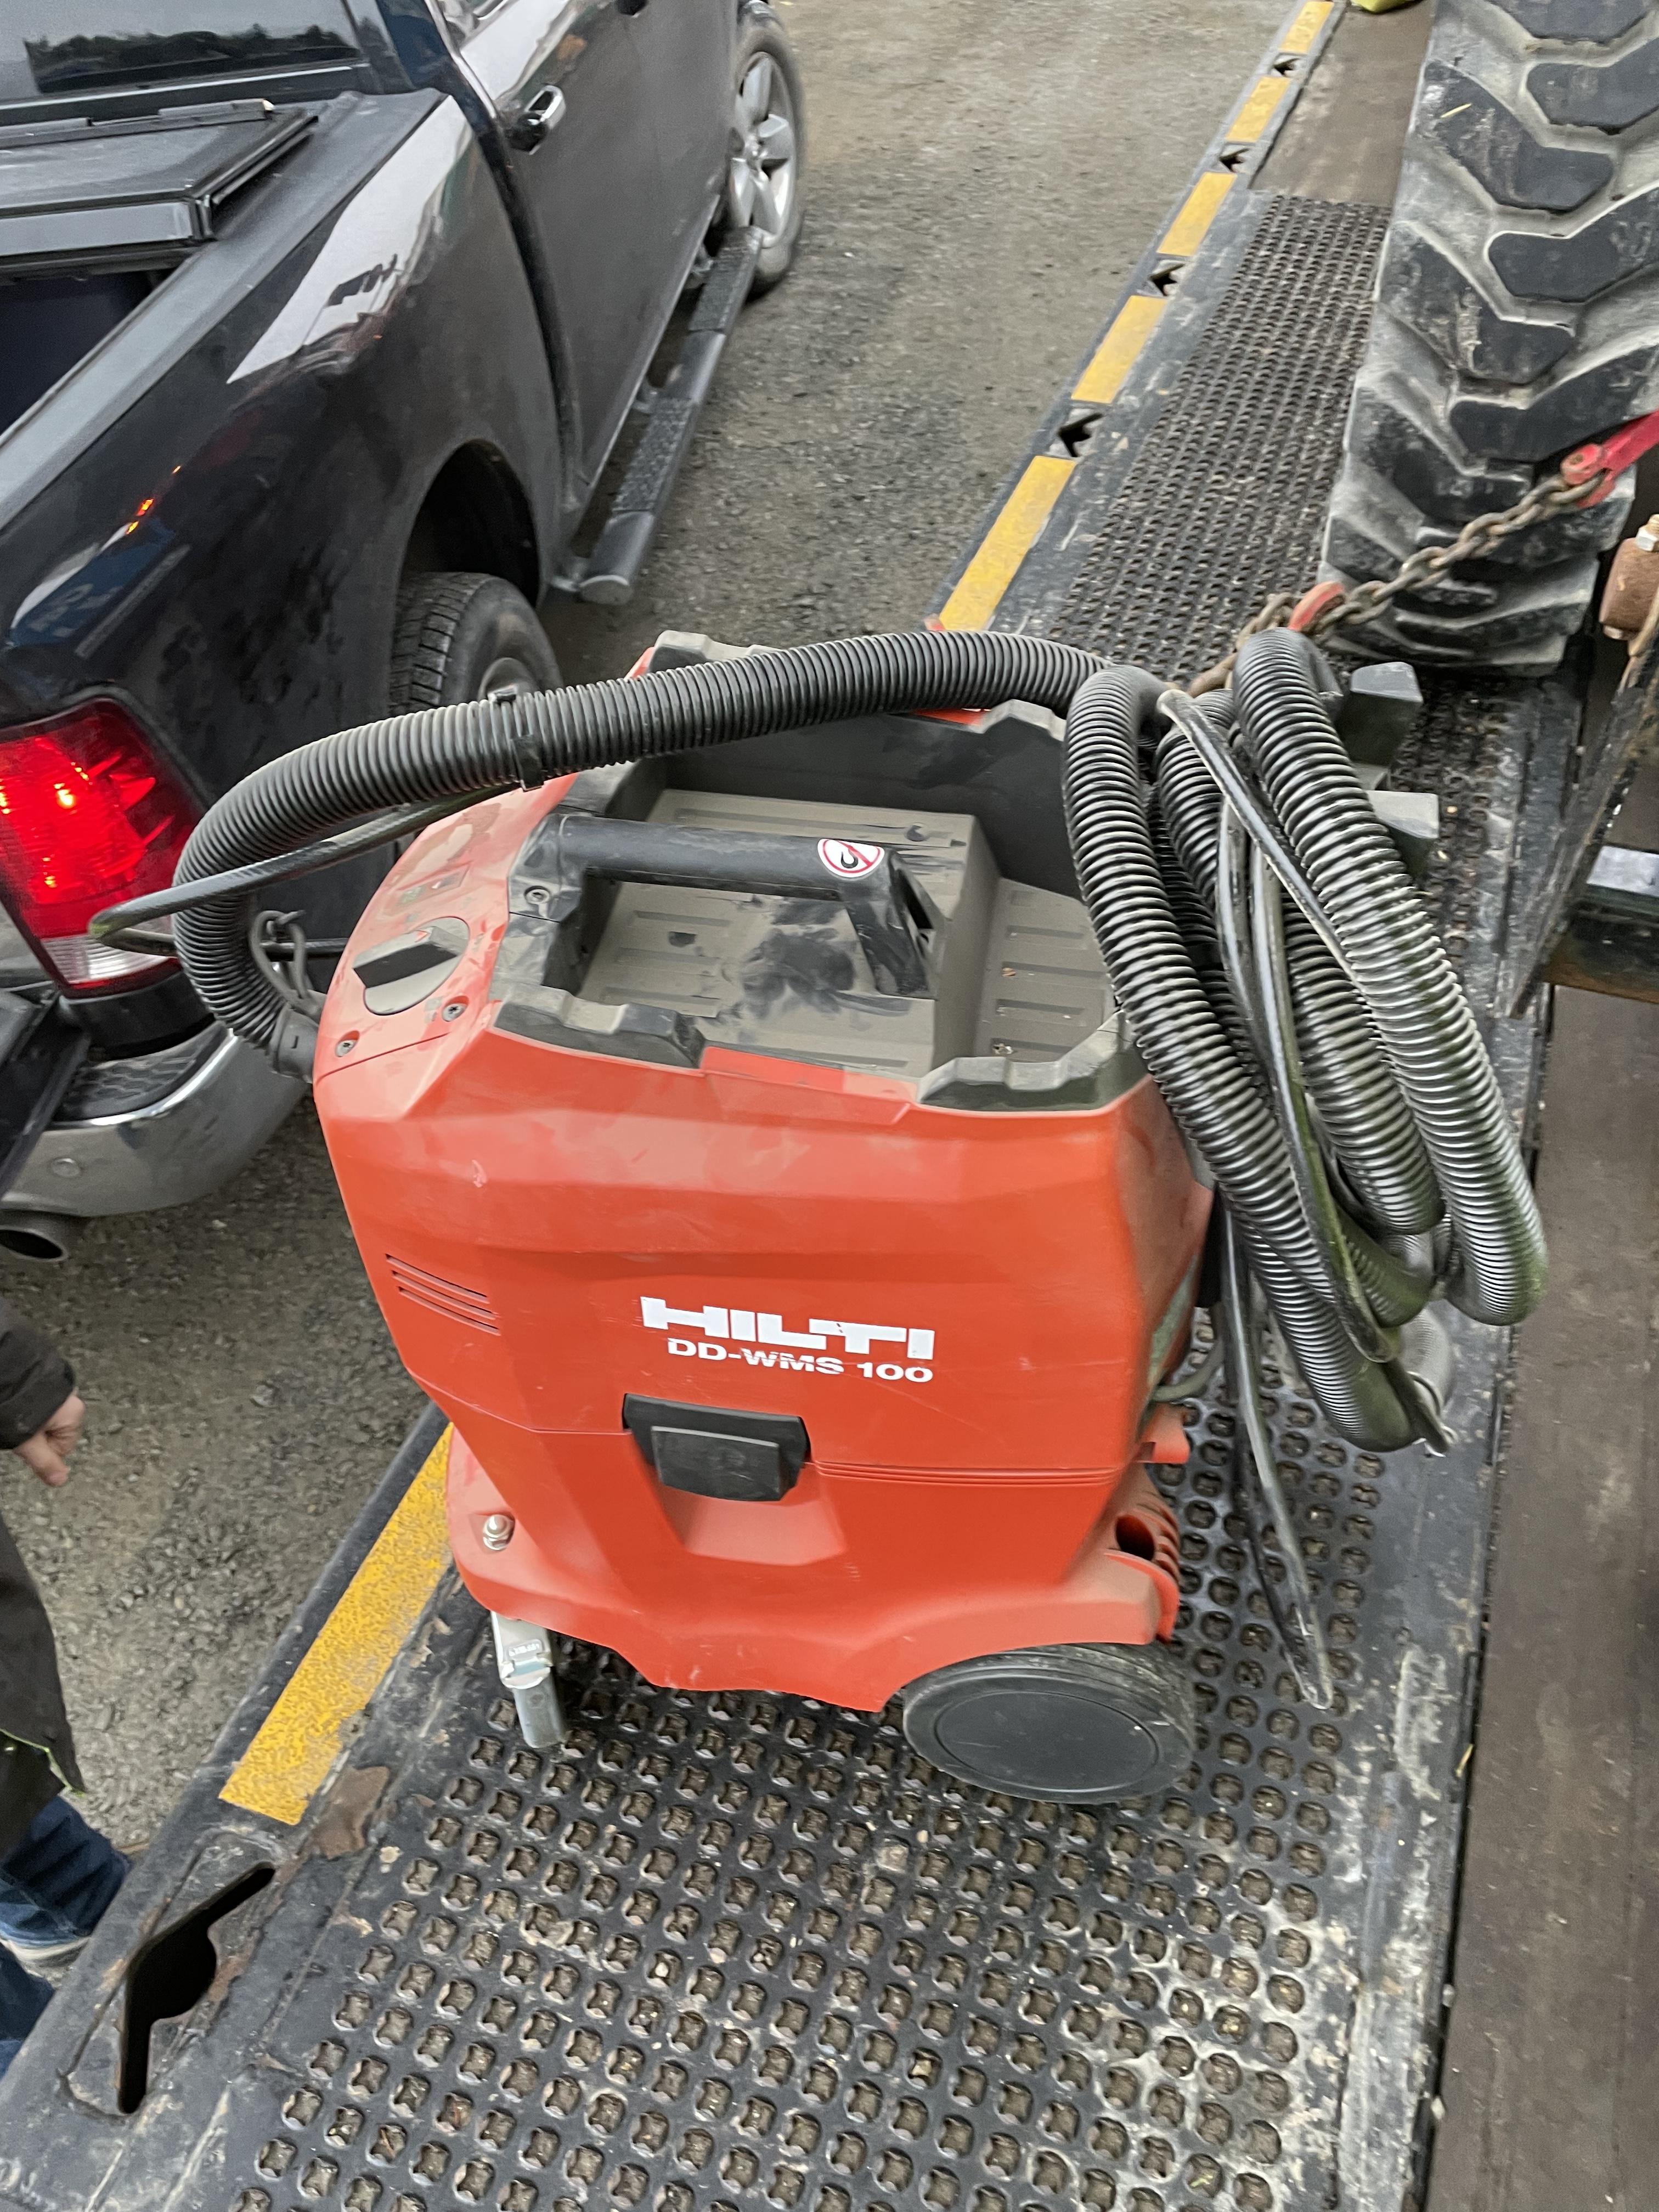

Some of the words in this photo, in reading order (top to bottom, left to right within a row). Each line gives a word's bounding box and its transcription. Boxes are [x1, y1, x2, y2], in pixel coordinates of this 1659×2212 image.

[640, 1296, 935, 1360] HILTI
[667, 1338, 844, 1374] DD-WMS
[856, 1362, 933, 1383] 100
